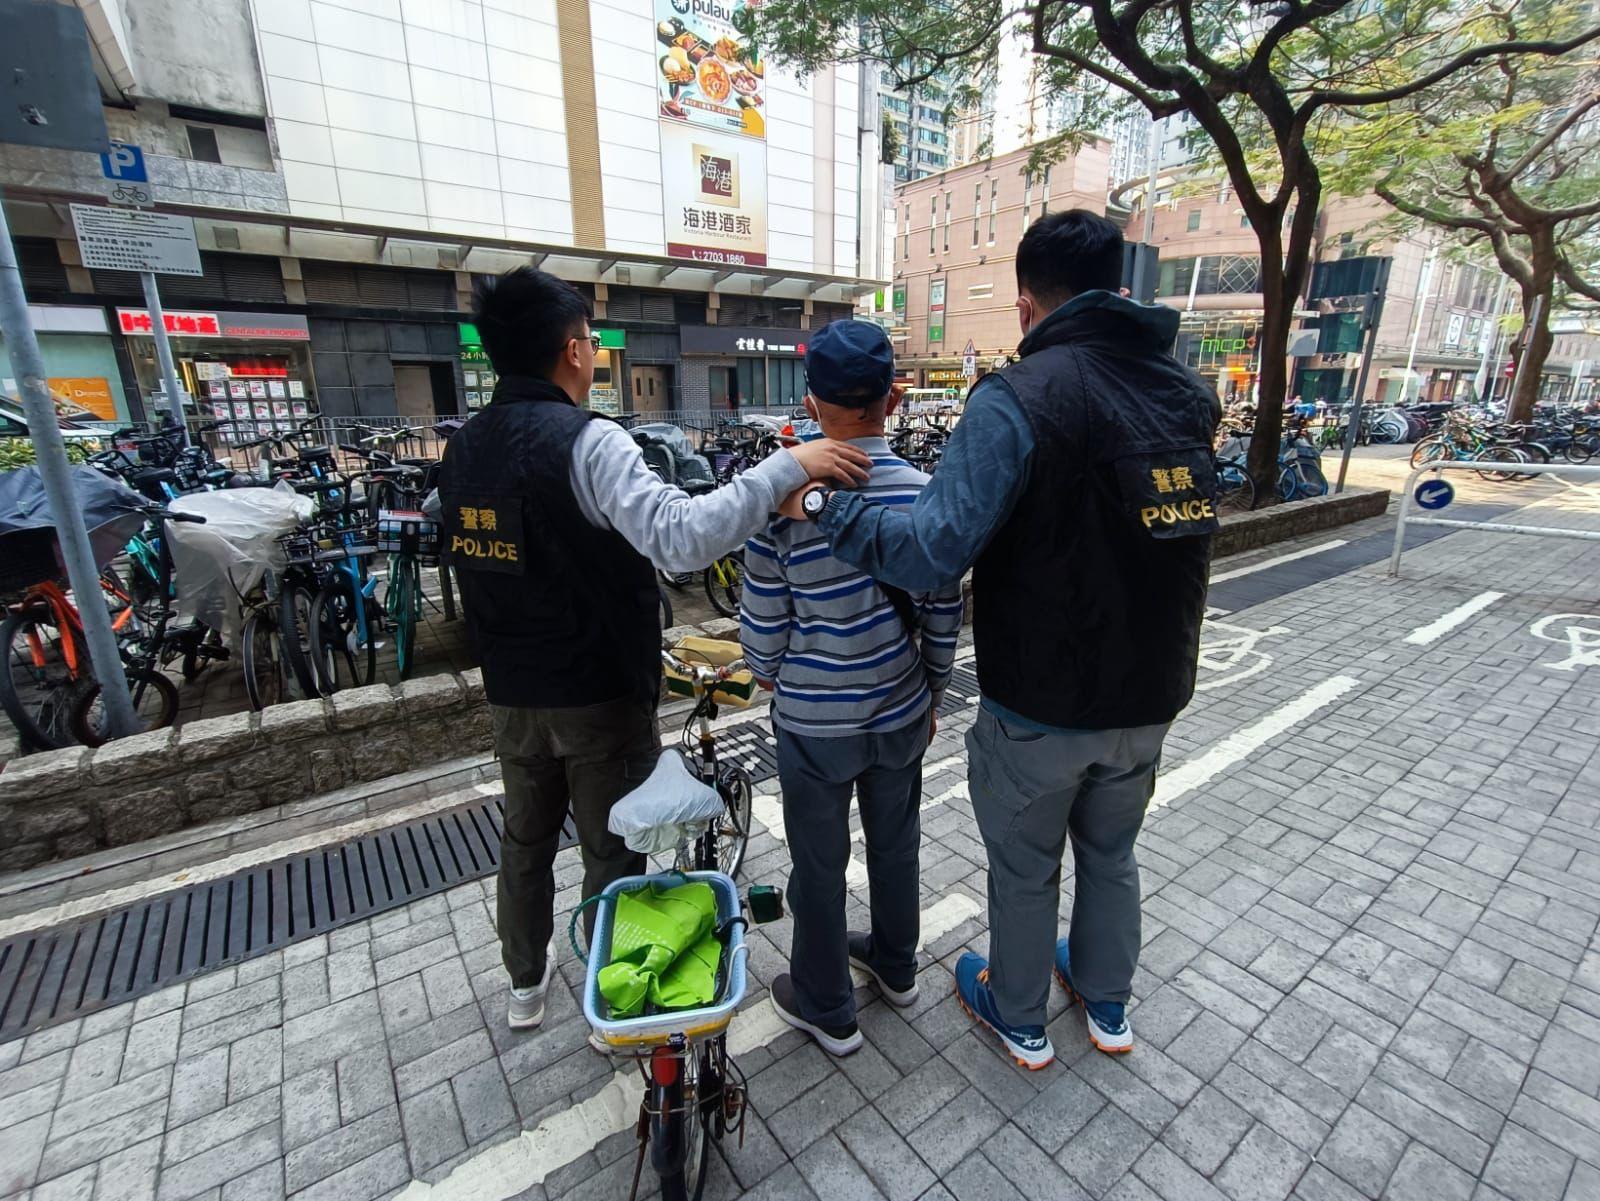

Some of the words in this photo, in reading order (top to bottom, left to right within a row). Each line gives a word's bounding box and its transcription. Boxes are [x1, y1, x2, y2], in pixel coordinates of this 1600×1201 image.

[692, 0, 730, 21] pulau
[108, 146, 136, 177] P
[700, 156, 732, 192] 海港
[683, 206, 751, 235] 海港酒家
[1151, 466, 1195, 492] 警察
[459, 506, 497, 531] 警察
[1141, 499, 1215, 528] POLICE
[451, 535, 518, 561] POLICE
